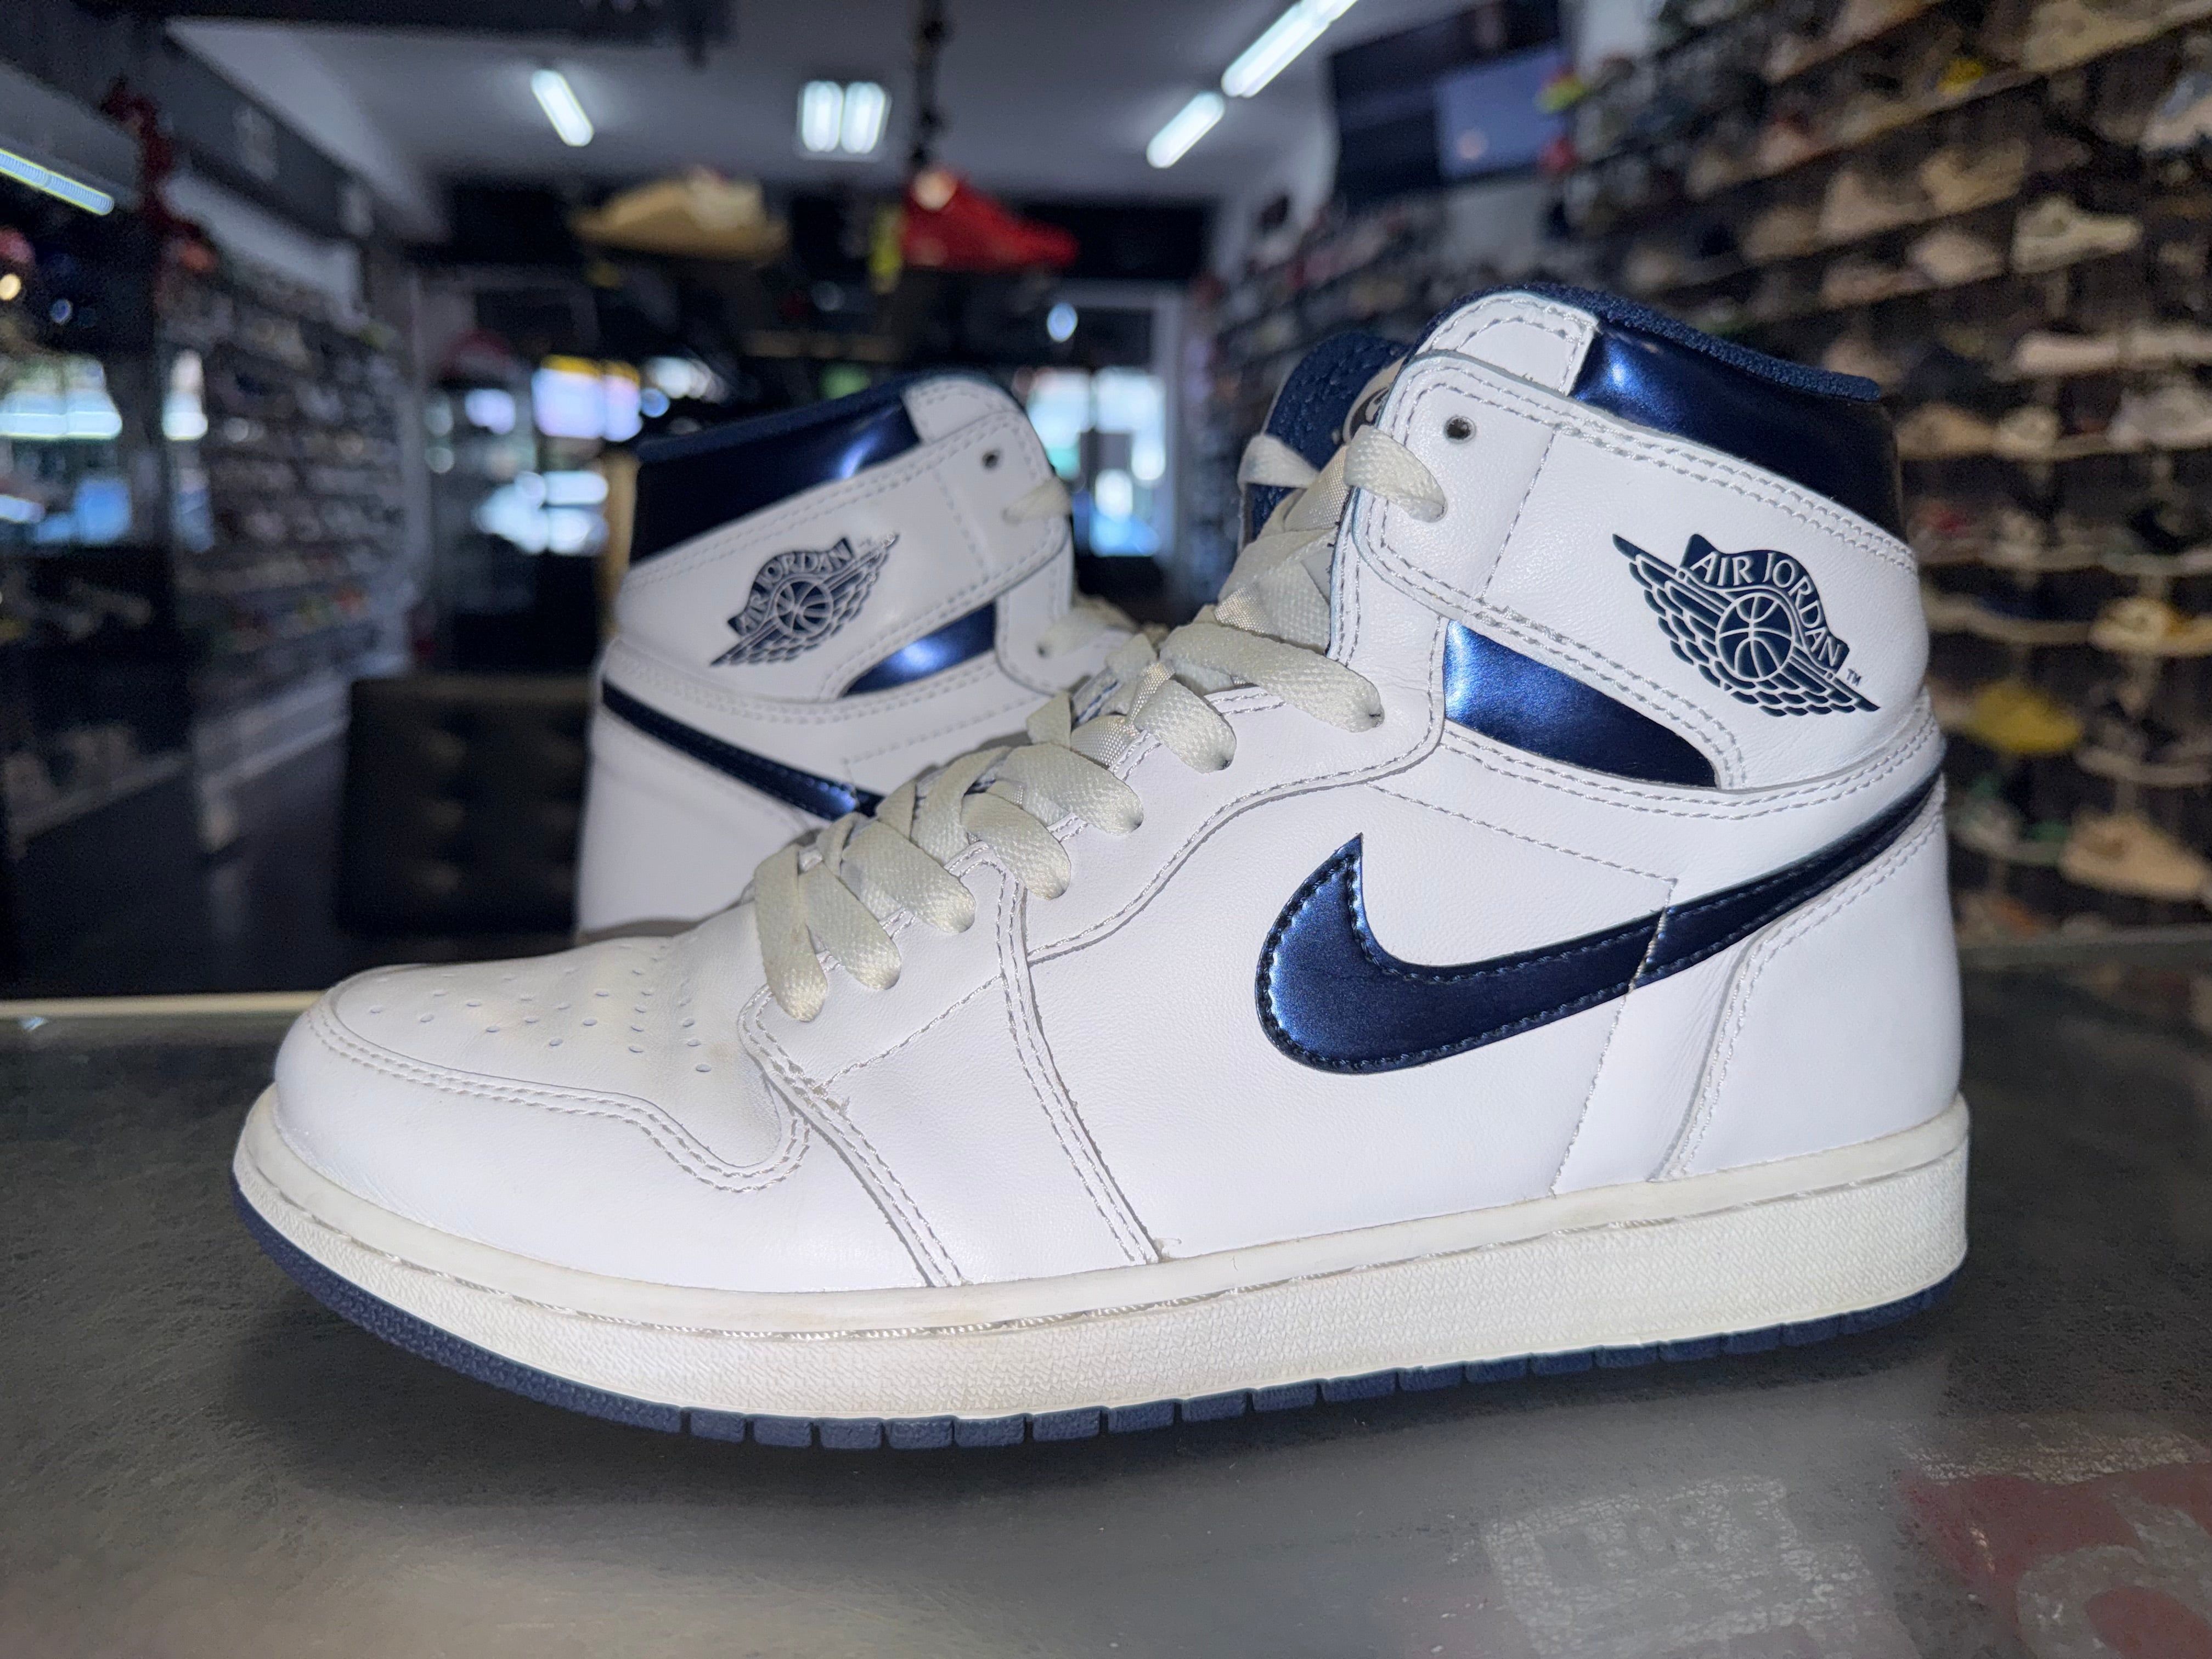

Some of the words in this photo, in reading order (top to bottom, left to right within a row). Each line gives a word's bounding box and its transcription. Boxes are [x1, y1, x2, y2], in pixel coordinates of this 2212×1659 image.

[757, 541, 853, 588] JORDAN
[1690, 551, 1754, 586] AIR
[1763, 552, 1842, 667] JORDAN
[1846, 668, 1862, 686] TM
